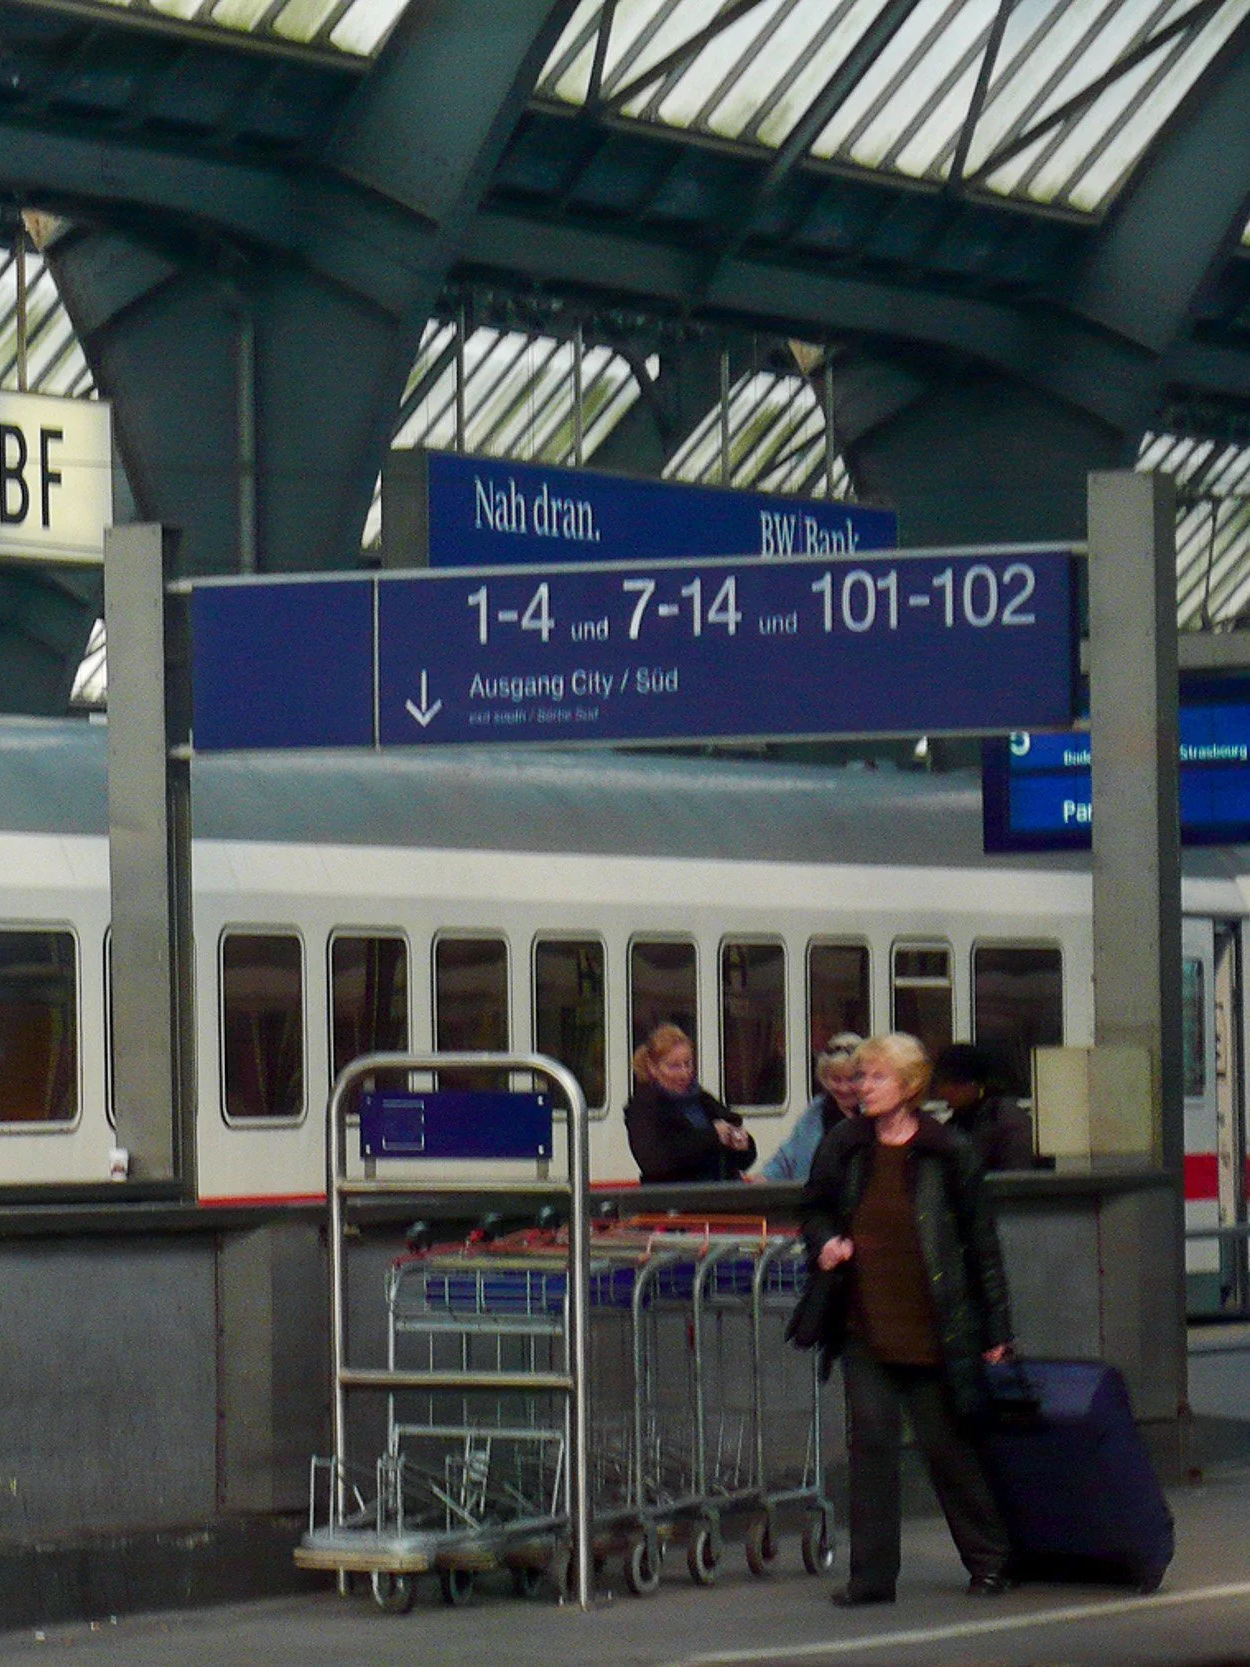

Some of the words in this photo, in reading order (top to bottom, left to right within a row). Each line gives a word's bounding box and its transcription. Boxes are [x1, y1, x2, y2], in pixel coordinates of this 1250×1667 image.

[474, 475, 526, 534] Nah
[533, 482, 600, 541] dran.
[805, 516, 860, 557] Bank
[467, 582, 555, 645] 1-4
[571, 616, 609, 642] und
[623, 575, 742, 640] 7-14
[758, 610, 798, 635] und
[812, 563, 1036, 633] 101-102
[469, 672, 565, 702] Ausgang
[571, 669, 613, 698] City
[636, 667, 679, 694] Süd
